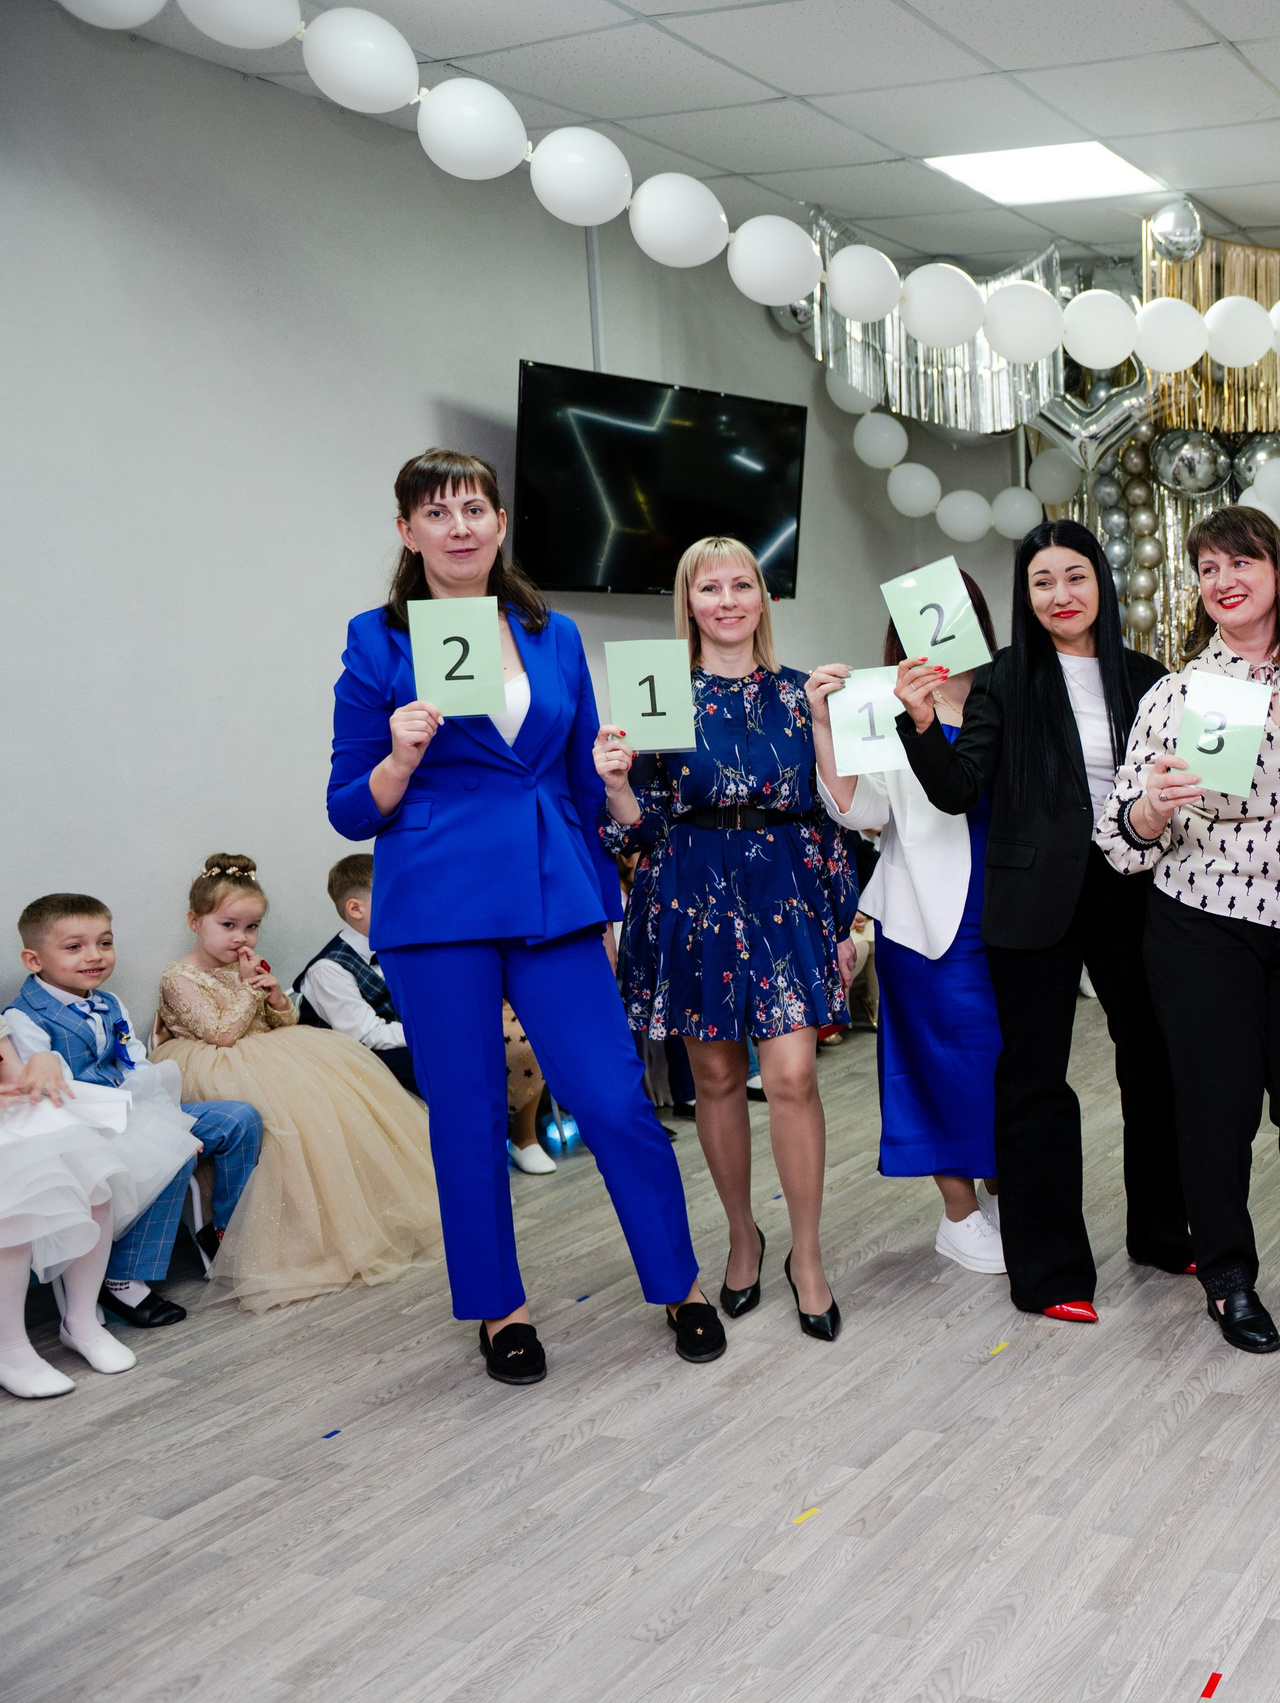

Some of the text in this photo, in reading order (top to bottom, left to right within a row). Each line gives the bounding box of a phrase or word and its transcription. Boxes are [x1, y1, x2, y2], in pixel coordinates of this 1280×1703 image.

[919, 602, 956, 648] 2
[442, 635, 475, 682] 2
[637, 674, 667, 718] 1
[858, 701, 886, 742] 1
[1195, 710, 1228, 756] 3
